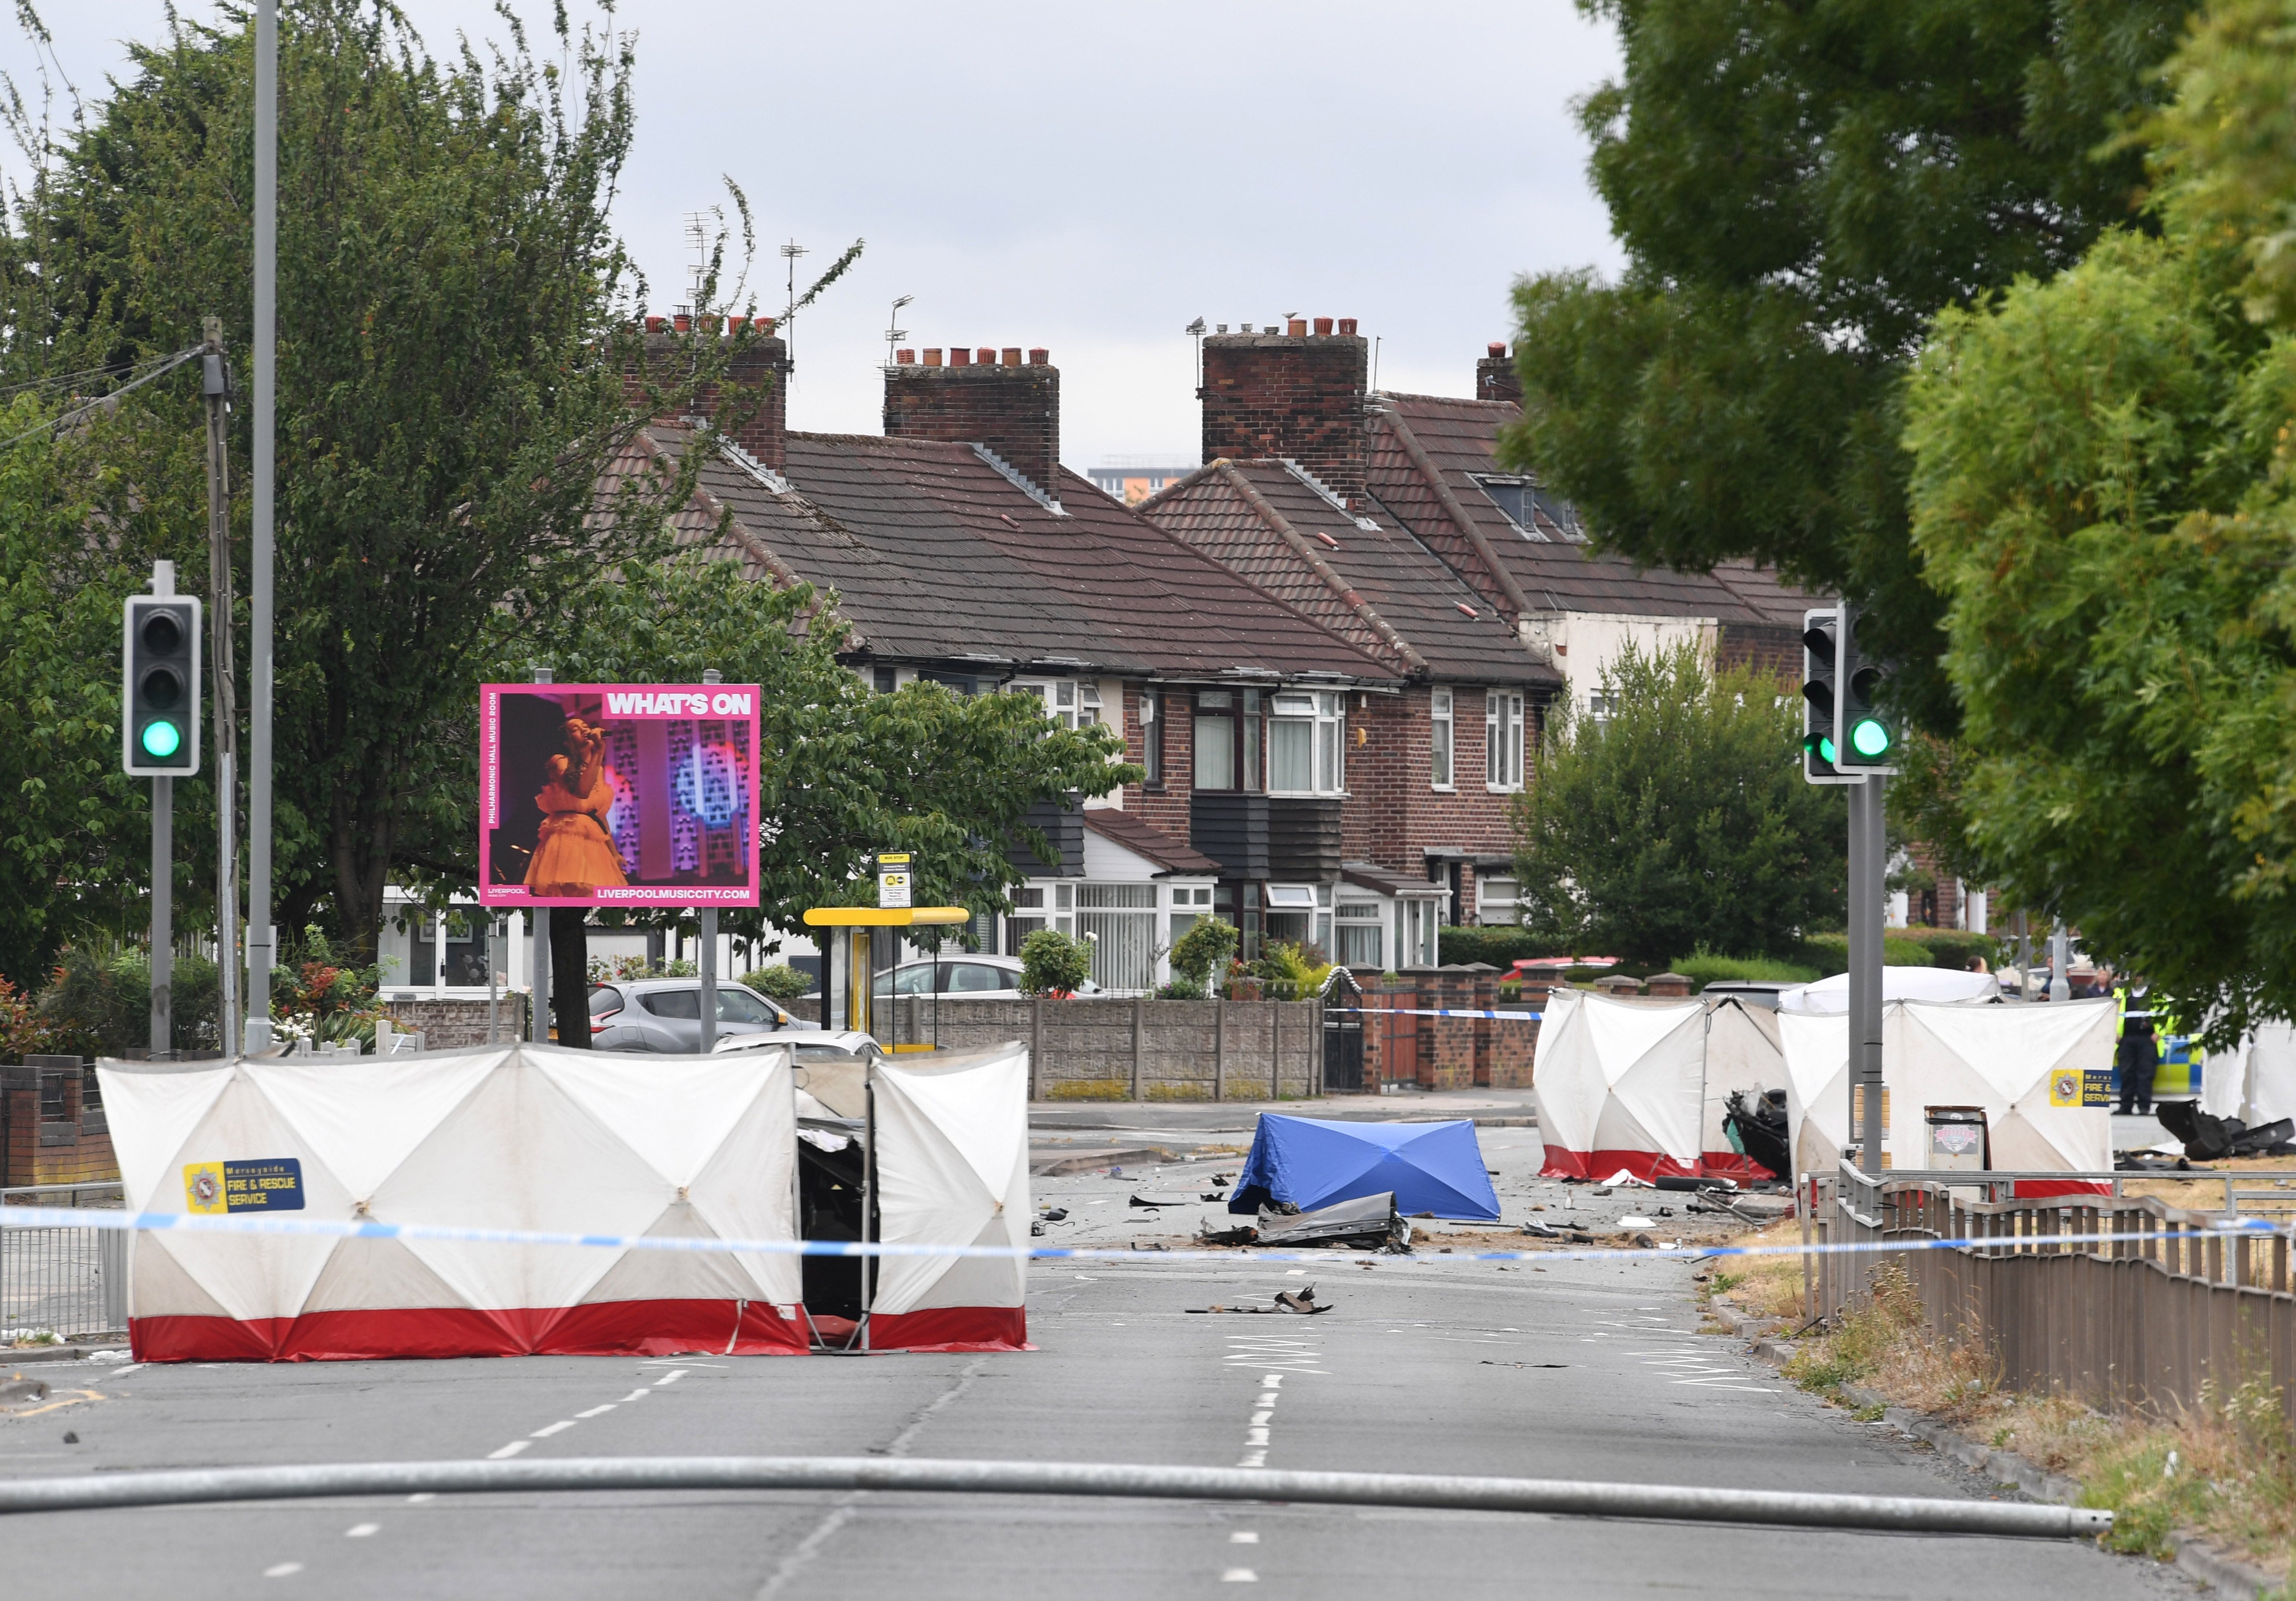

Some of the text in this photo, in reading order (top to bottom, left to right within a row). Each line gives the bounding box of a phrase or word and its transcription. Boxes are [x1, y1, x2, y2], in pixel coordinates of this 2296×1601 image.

[607, 693, 751, 715] WHAT'S ON
[597, 889, 750, 899] LIVERPOOLMUSICCITY.COM
[2084, 1083, 2103, 1092] FIRE
[226, 1165, 285, 1175] Merseyside
[227, 1177, 296, 1191] FIRE & RESCUE
[228, 1193, 267, 1206] SERVICE
